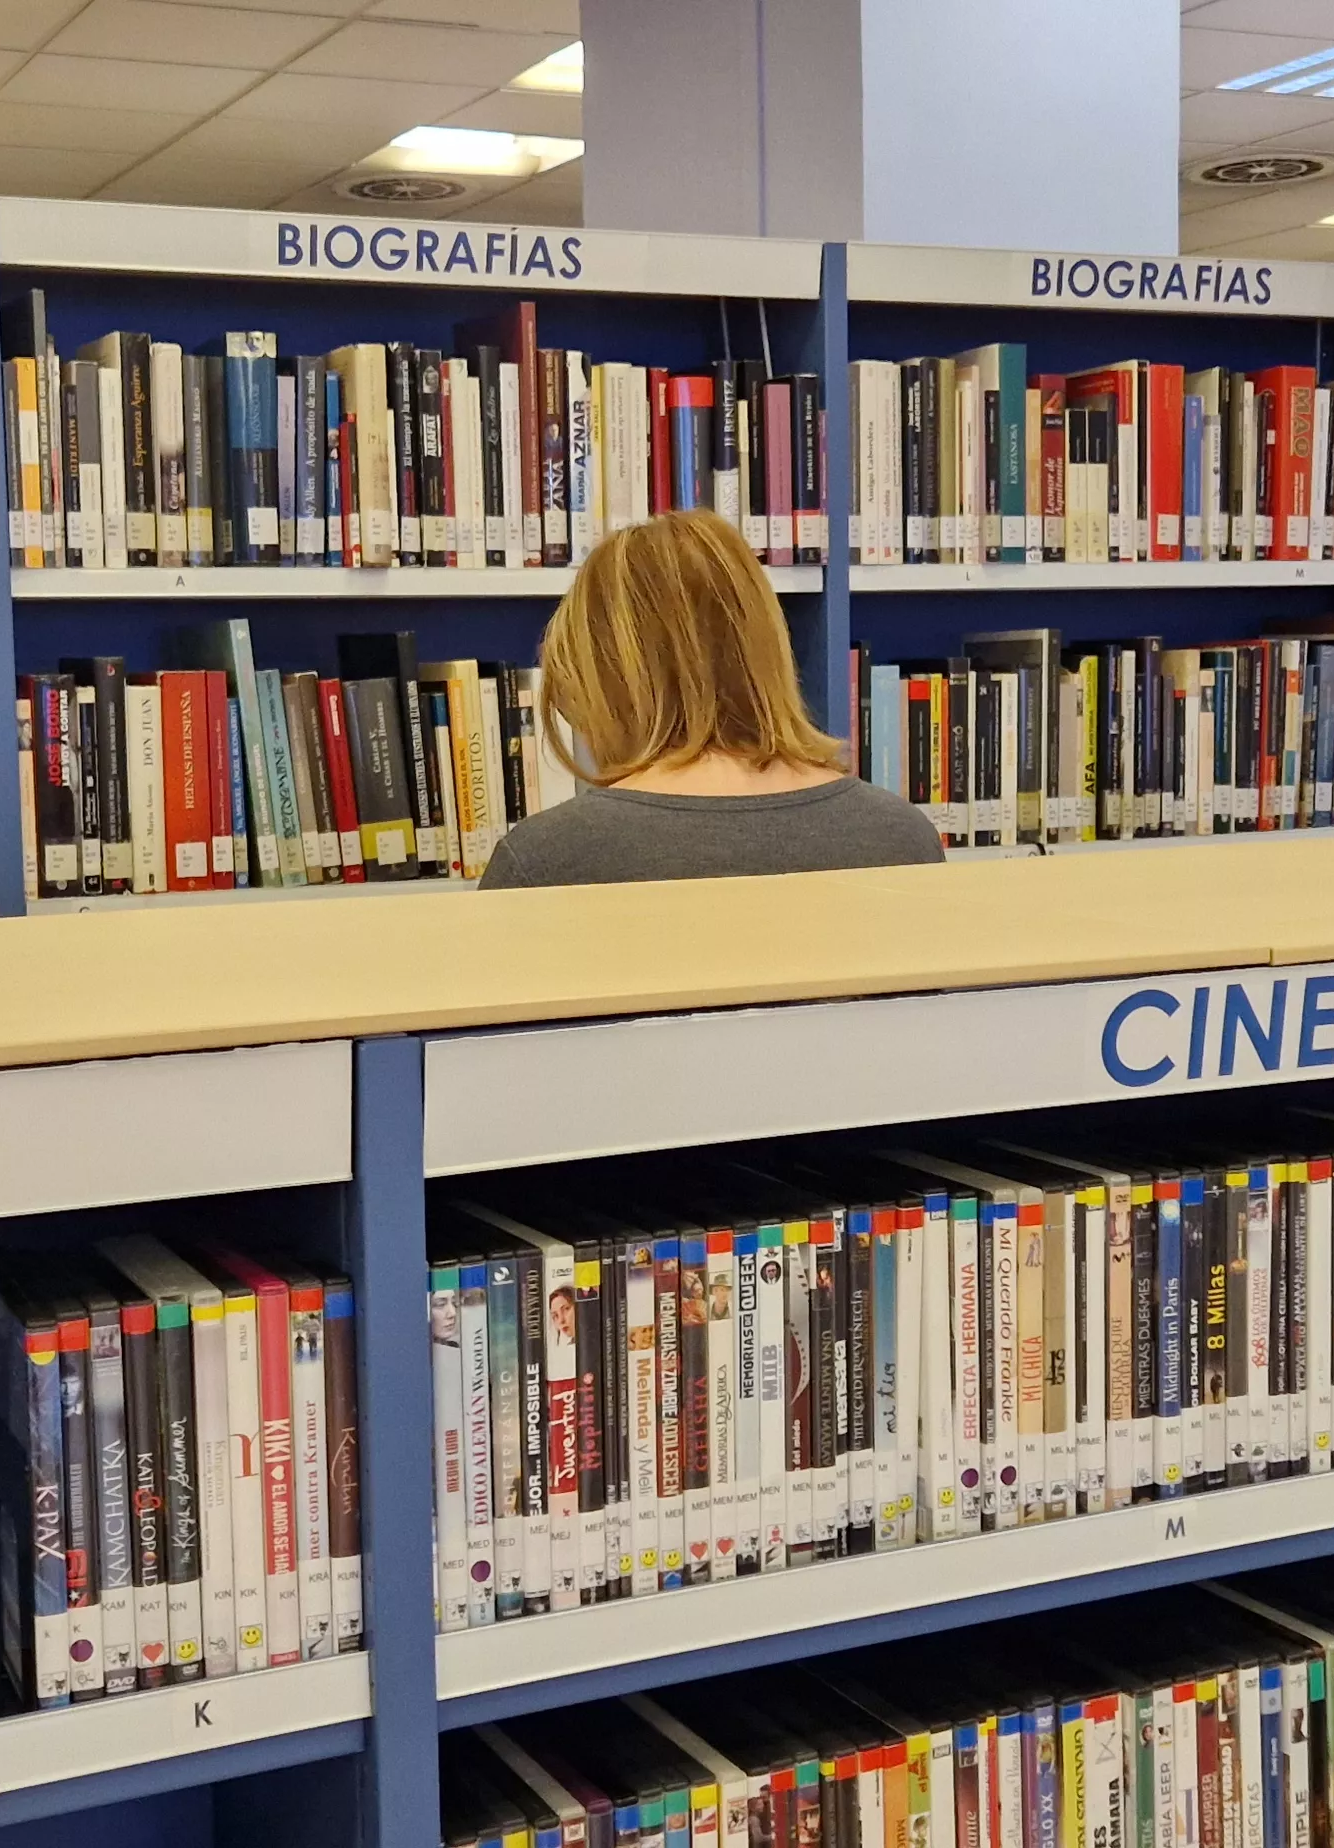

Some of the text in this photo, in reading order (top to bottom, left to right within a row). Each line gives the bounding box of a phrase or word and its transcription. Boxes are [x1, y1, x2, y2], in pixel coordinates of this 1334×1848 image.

[278, 223, 582, 280] BIOGRAFÍAS
[1032, 258, 1272, 306] BIOGRAFÍAS
[132, 366, 144, 468] Esperanza Aguirre
[426, 414, 437, 458] ARAFAT
[572, 400, 585, 467] AZNAR
[1291, 386, 1311, 458] MAO
[1045, 475, 1055, 518] Leonor
[175, 576, 185, 587] A
[1295, 568, 1305, 578] M
[47, 690, 60, 786] JOSÉ BONO
[142, 699, 154, 767] DON JUAN
[180, 691, 195, 809] REINAS DE ESPAÑA
[740, 1254, 755, 1398] MEMORIAS QUEEN
[962, 1263, 976, 1356] HERMANA
[999, 1255, 1015, 1342] Querido
[1163, 1321, 1177, 1335] in
[1207, 1264, 1225, 1349] 8 Millas
[1020, 1336, 1041, 1402] MI CHICA
[1139, 1343, 1151, 1408] MIENTRAS
[1163, 1338, 1180, 1402] Midnight
[1189, 1298, 1198, 1385] DOLLAR BABY
[527, 1362, 541, 1454] IMPOSIBLE
[635, 1358, 652, 1452] Melinda y
[835, 1339, 848, 1435] mensaka
[999, 1346, 1013, 1424] Frankie
[305, 1400, 320, 1527] contra Kramer
[467, 1394, 487, 1468] ALEMÁN
[552, 1389, 577, 1487] Juventud
[102, 1439, 131, 1588] KAMCHATKA
[168, 1416, 195, 1551] Kings of Summer
[264, 1418, 290, 1554] KIKI EL AMOR SE
[467, 1473, 489, 1526] ÉDICO
[34, 1484, 65, 1560] K-PAX
[1165, 1516, 1185, 1541] M
[193, 1701, 212, 1728] K
[1158, 1761, 1172, 1809] LEER
[1200, 1774, 1214, 1826] MURDER
